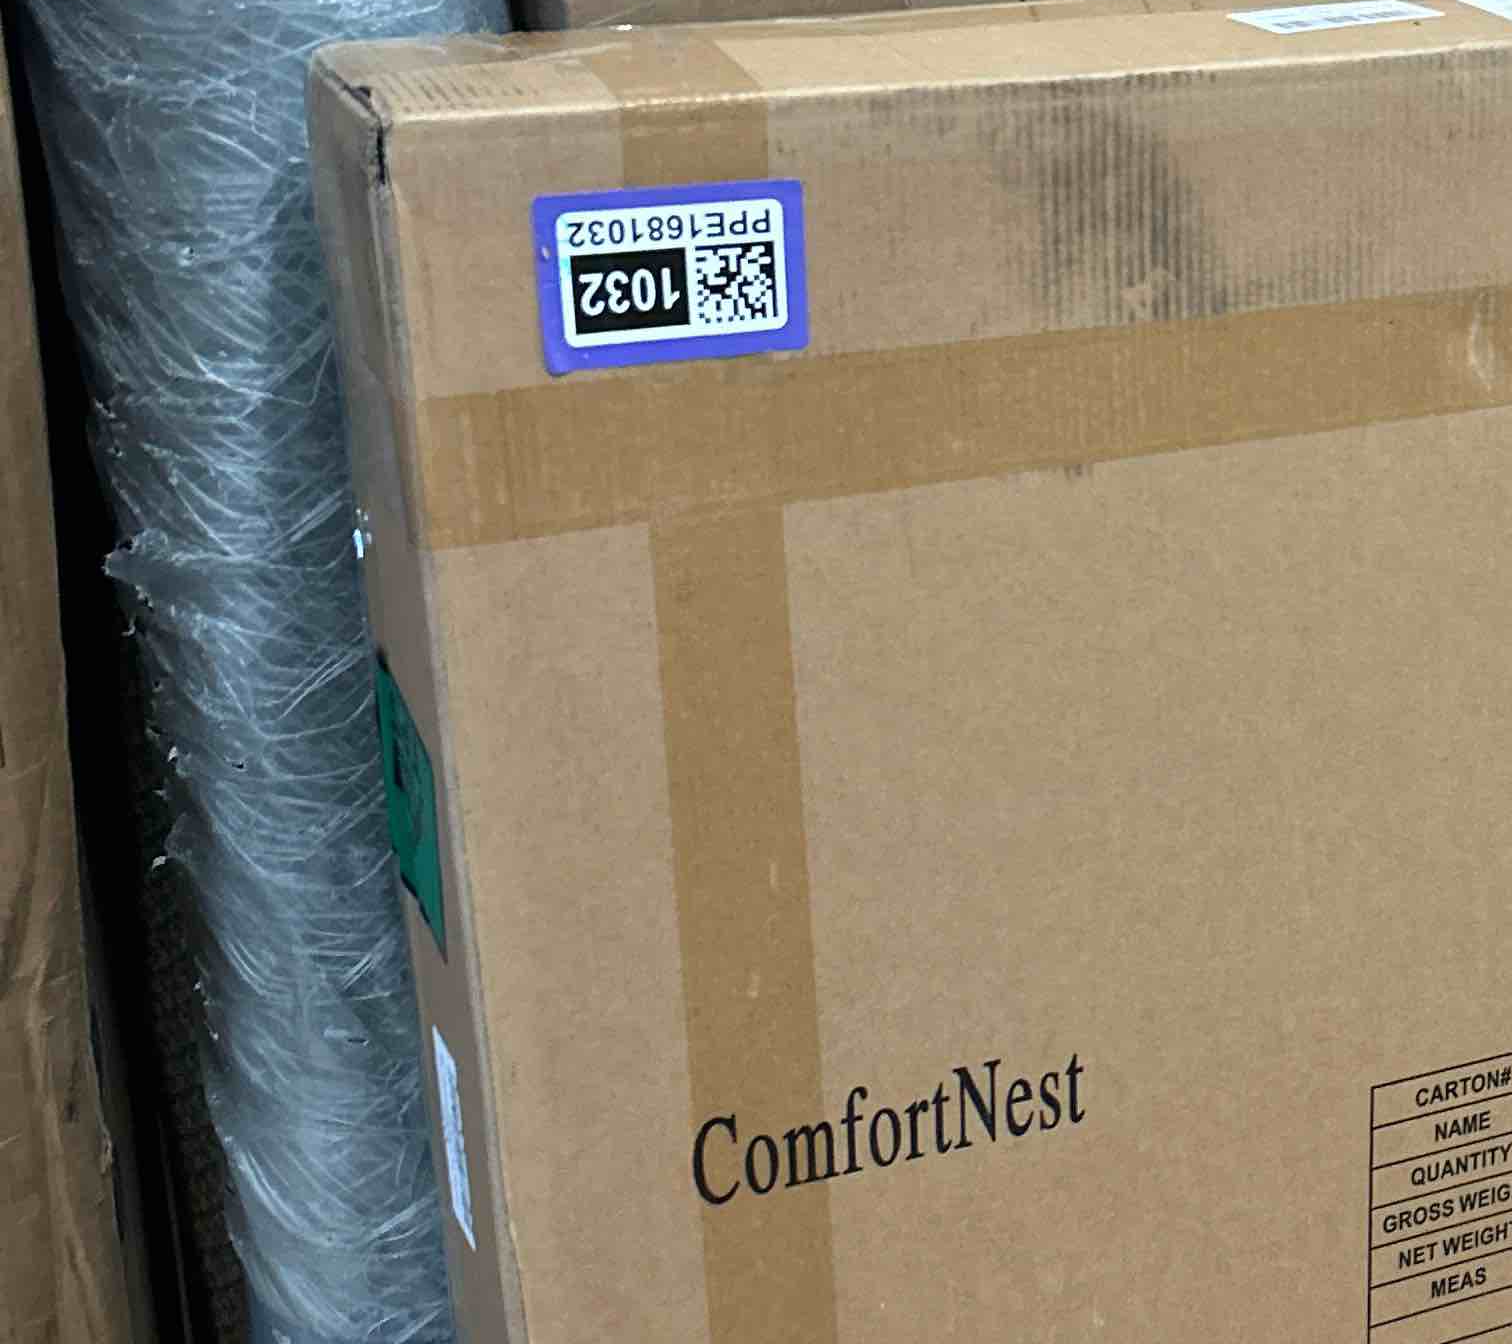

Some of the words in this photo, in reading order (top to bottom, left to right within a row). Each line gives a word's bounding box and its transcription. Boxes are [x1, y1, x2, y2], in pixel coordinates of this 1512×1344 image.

[567, 208, 771, 247] PPE1681032
[578, 267, 681, 317] 1032
[1415, 1065, 1512, 1108] CARTON#
[692, 1053, 1085, 1205] ComfortNest
[1434, 1109, 1492, 1143] NAME
[1410, 1142, 1512, 1187] QUANTITY
[1382, 1198, 1455, 1234] GROSS
[1397, 1241, 1439, 1270] NET
[1430, 1266, 1487, 1300] MEAS
